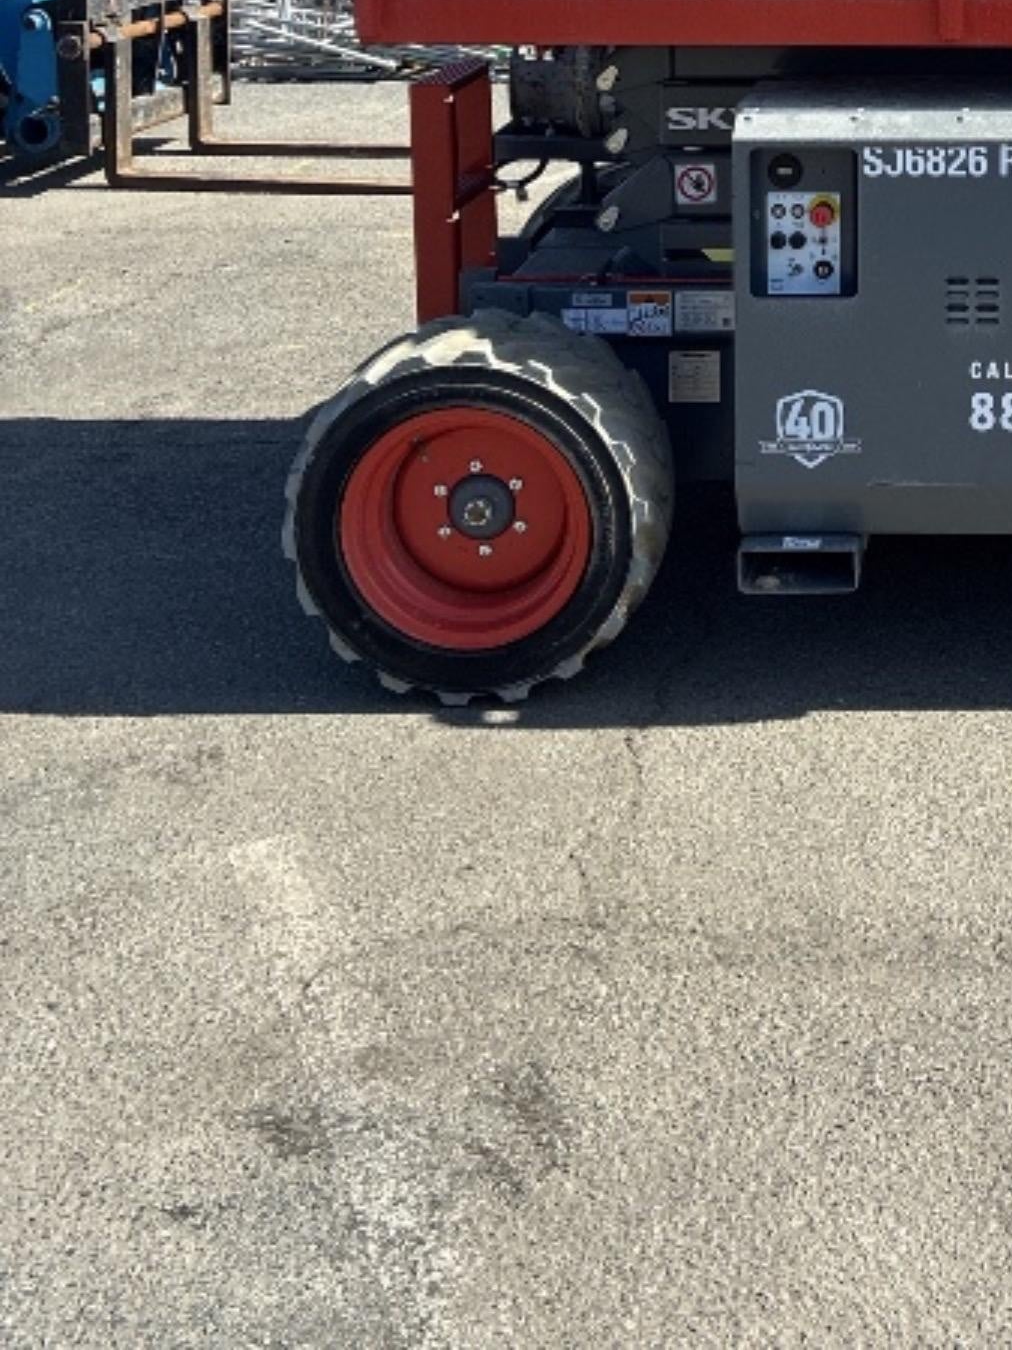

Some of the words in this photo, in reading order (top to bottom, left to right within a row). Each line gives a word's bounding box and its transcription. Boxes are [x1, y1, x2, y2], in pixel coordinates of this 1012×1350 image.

[665, 107, 736, 130] SK
[862, 145, 989, 178] SJ6826
[784, 397, 836, 442] 40
